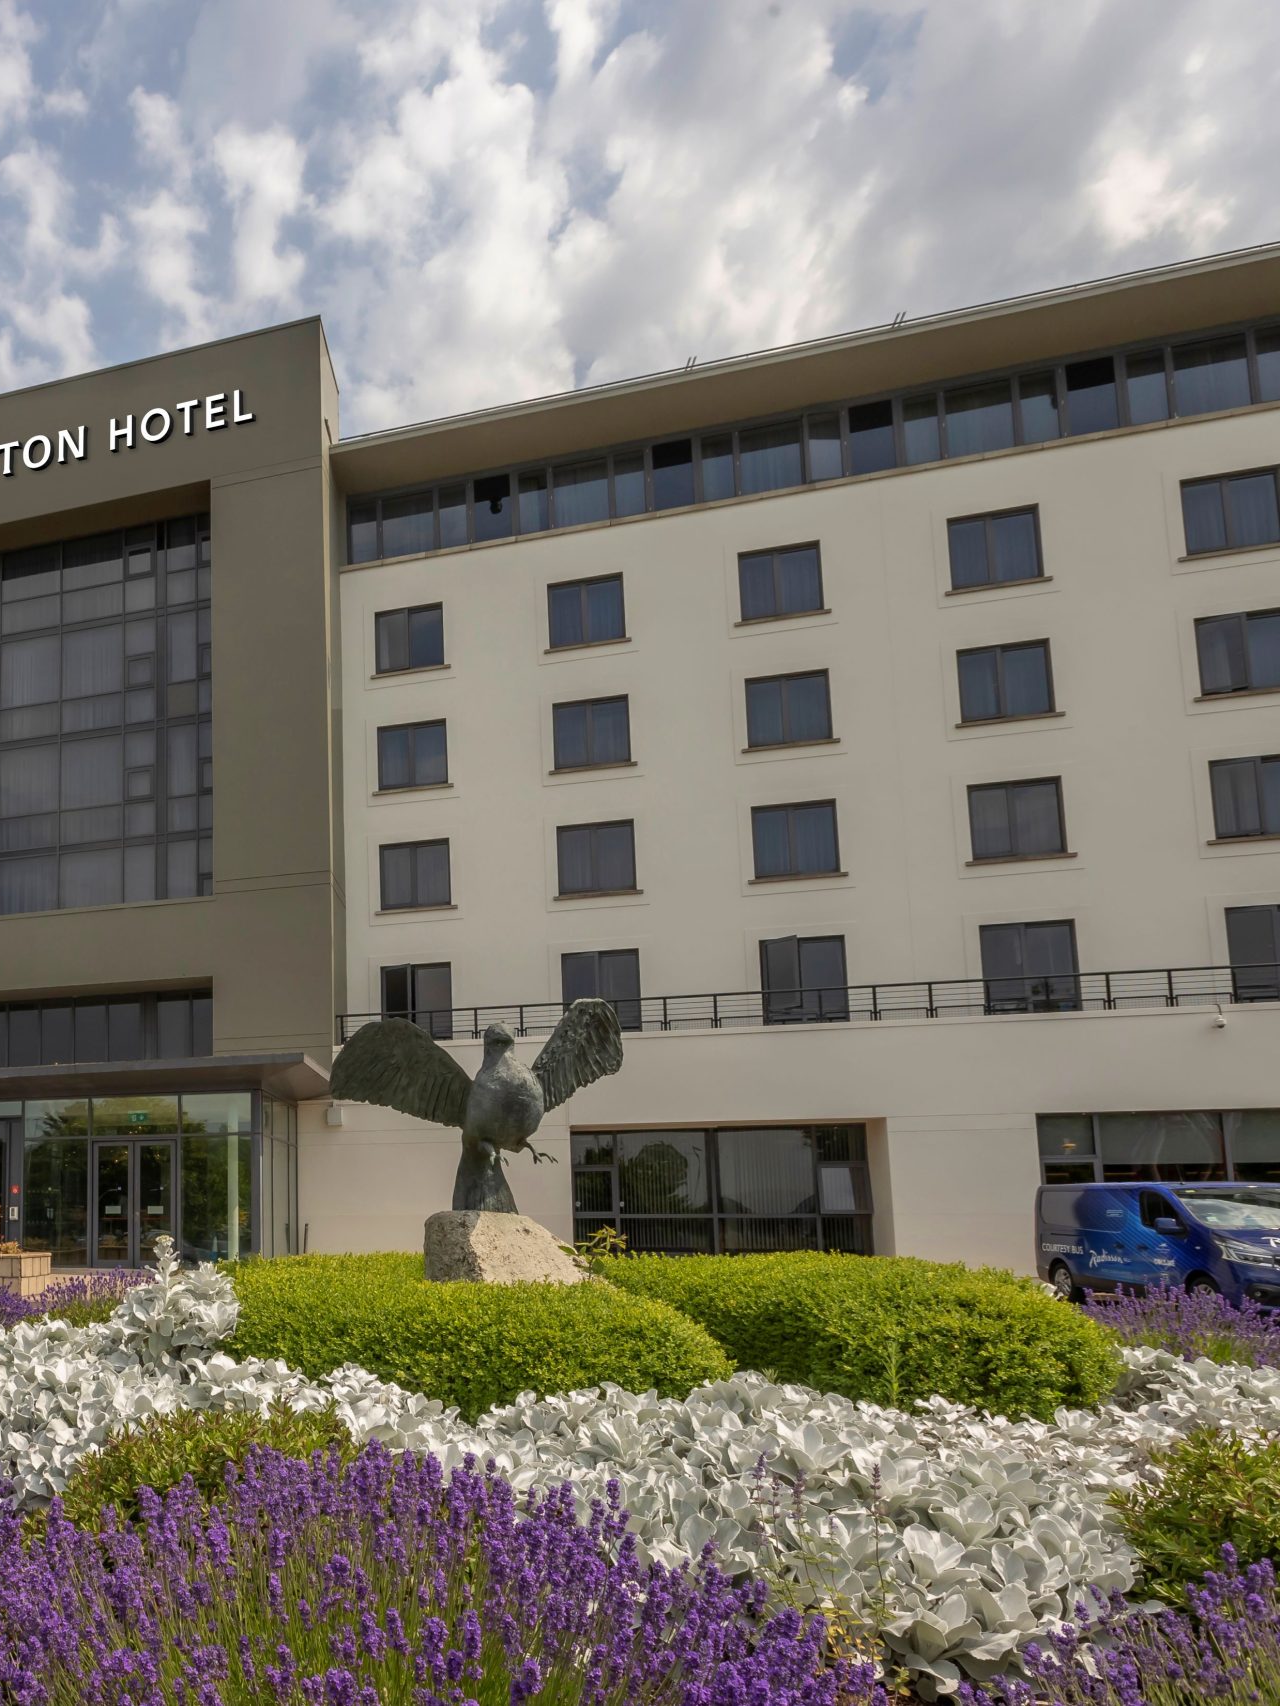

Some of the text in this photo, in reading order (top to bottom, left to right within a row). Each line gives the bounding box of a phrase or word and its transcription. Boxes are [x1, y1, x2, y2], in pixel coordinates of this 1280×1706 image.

[109, 389, 255, 452] HOTEL
[1041, 1242, 1084, 1255] COURTESY BUS
[1088, 1248, 1124, 1268] Radisson
